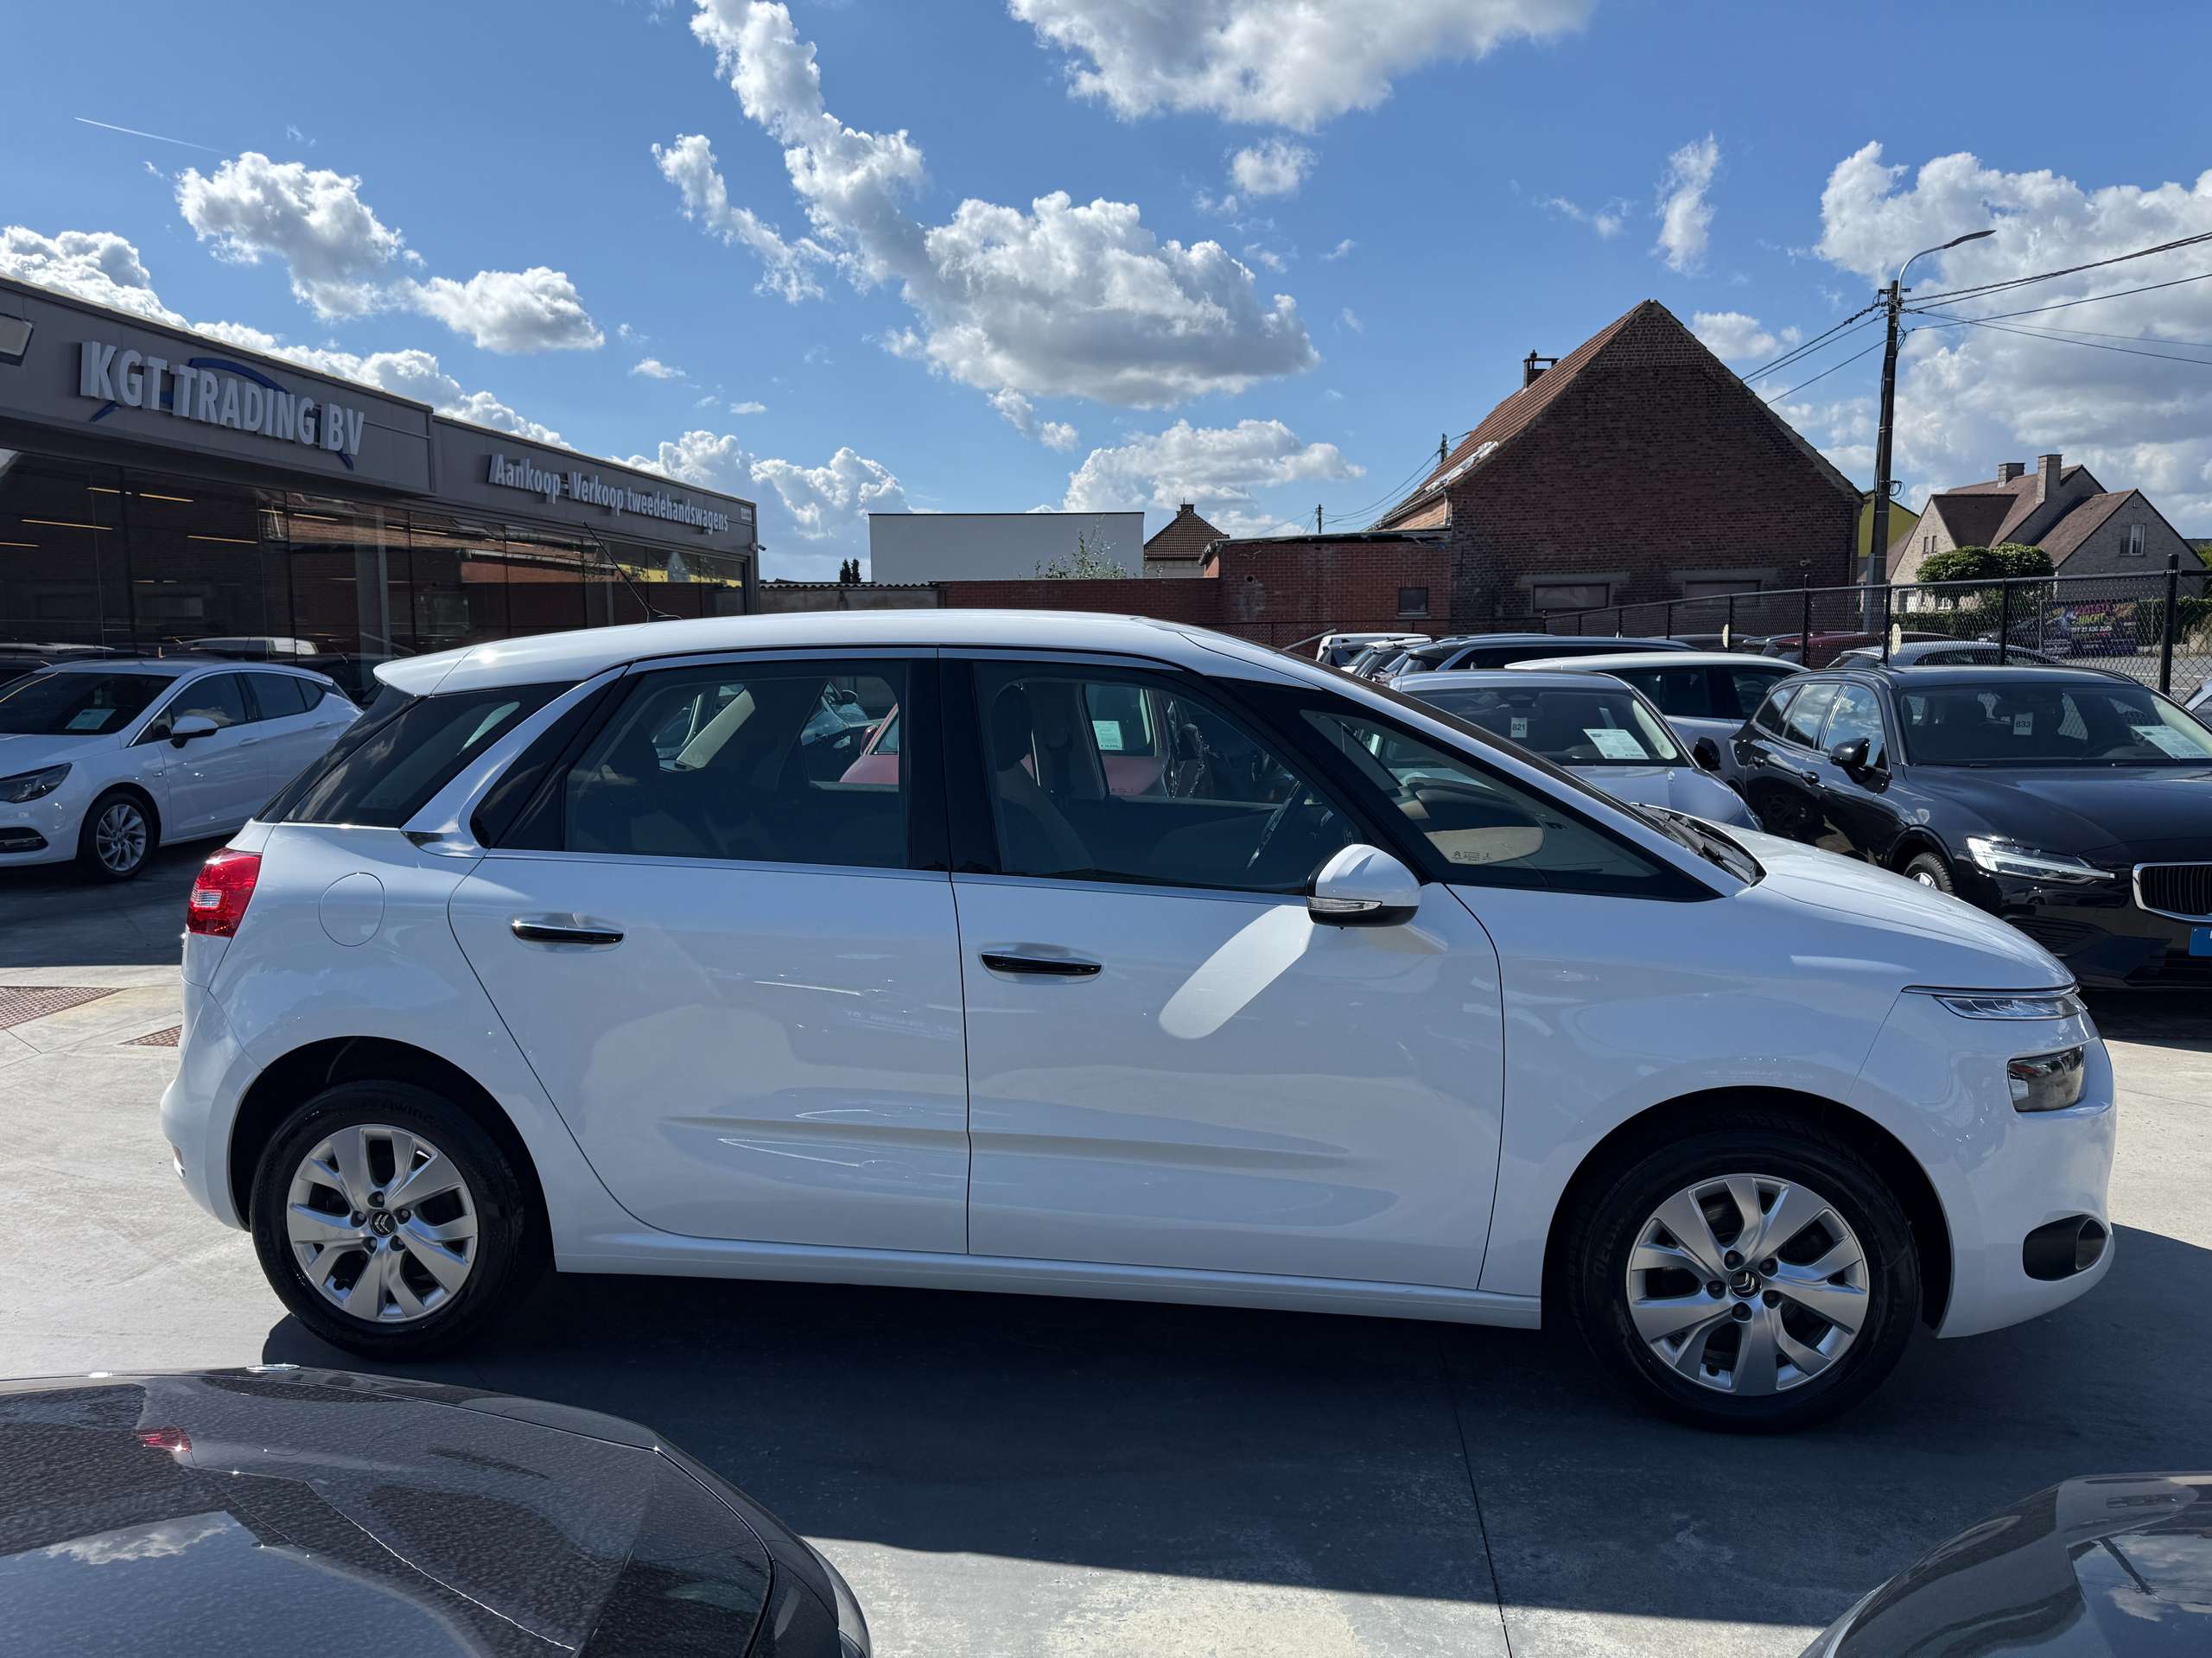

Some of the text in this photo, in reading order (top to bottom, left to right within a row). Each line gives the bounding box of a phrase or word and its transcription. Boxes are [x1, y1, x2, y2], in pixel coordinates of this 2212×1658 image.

[80, 340, 365, 456] KGT TRADING BV
[490, 454, 561, 504] Aankoop
[571, 471, 624, 517] Verkoop
[627, 486, 728, 536] tweedehandswagens
